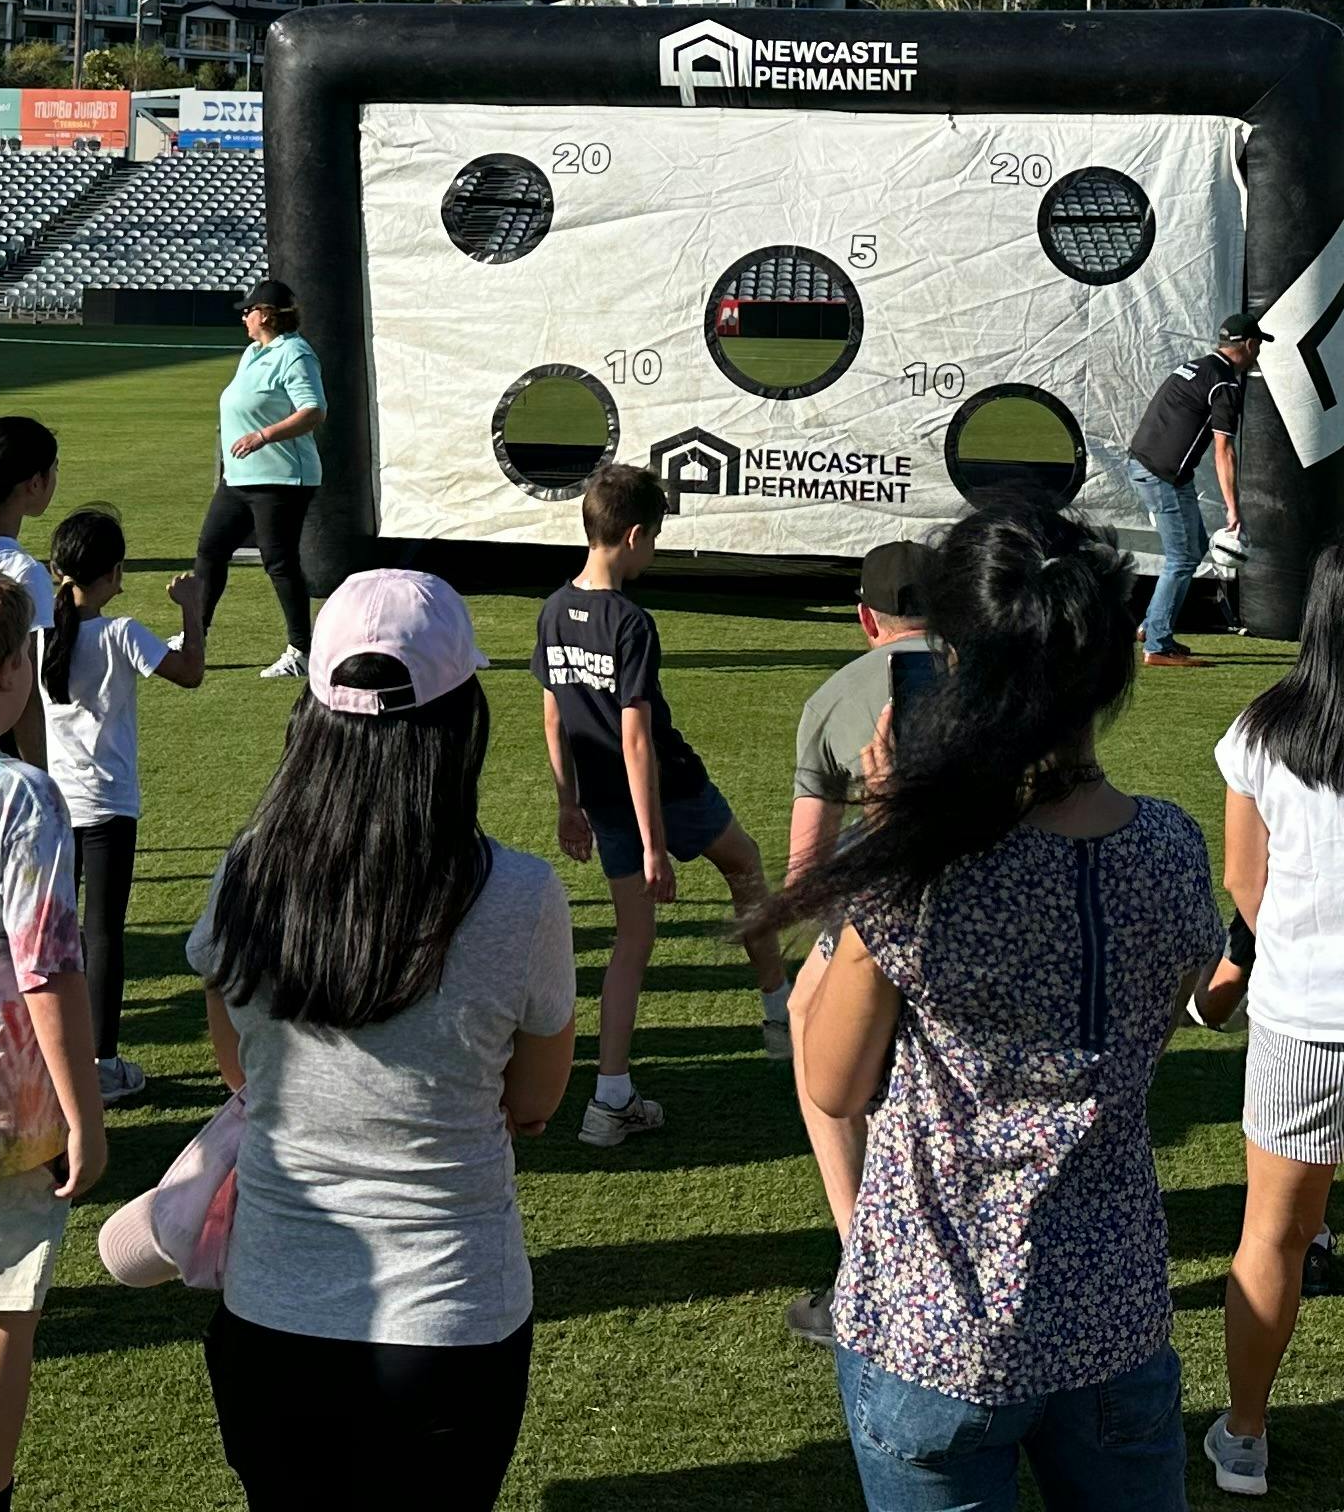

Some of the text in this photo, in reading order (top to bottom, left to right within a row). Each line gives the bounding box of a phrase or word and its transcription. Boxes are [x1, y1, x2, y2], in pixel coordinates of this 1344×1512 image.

[755, 40, 918, 64] NEWCASTLE
[755, 67, 918, 91] PERMANENT
[552, 142, 612, 175] 20
[990, 152, 1053, 188] 20
[847, 234, 878, 270] 5
[603, 348, 663, 386] 10
[902, 361, 965, 400] 10
[745, 448, 911, 476] NEWCASTLE
[744, 476, 911, 503] PERMANENT
